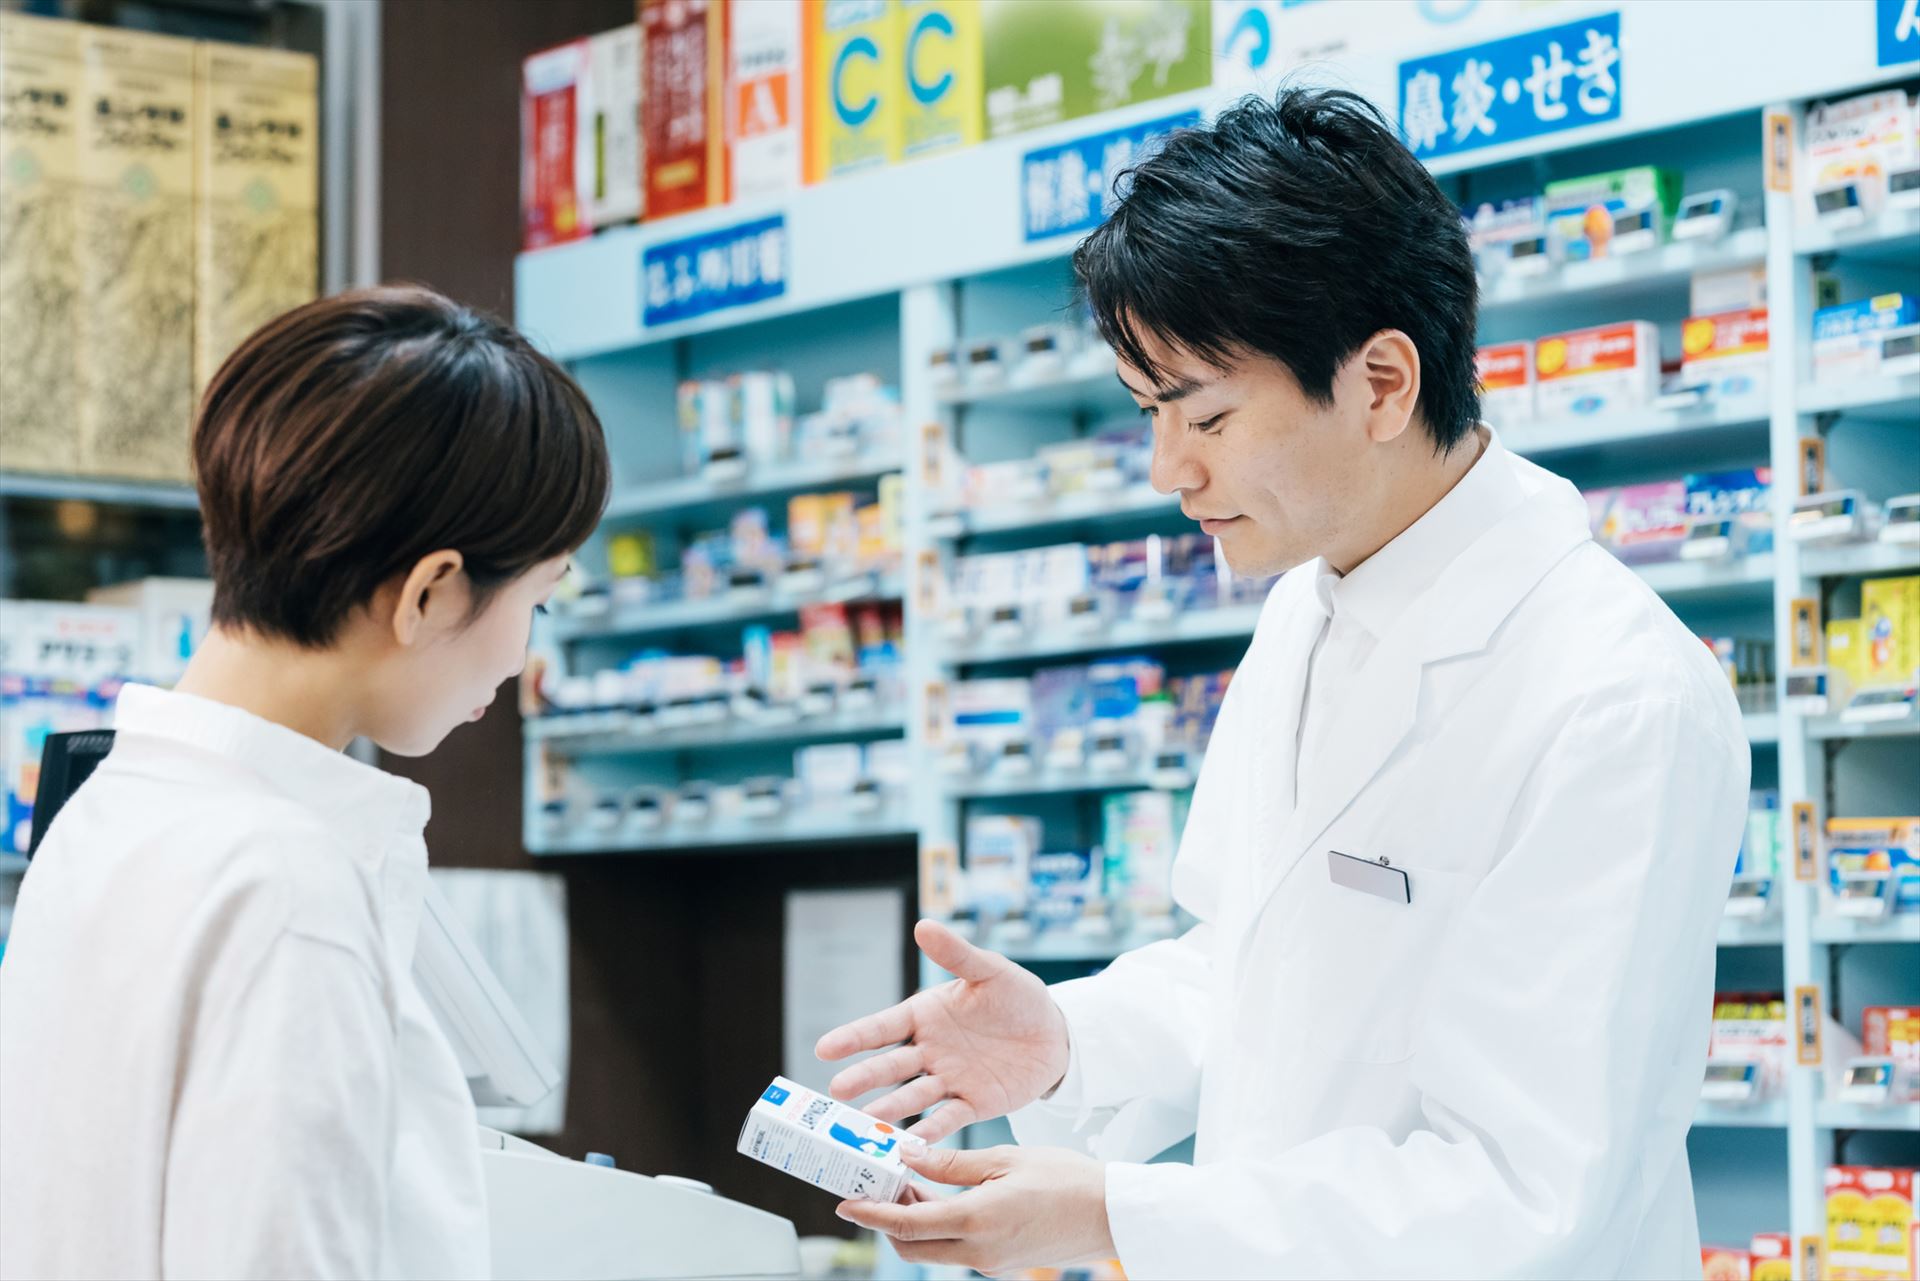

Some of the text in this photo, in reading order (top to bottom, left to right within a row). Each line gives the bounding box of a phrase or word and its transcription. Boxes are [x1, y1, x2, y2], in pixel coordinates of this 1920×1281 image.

[831, 36, 878, 127] C
[905, 11, 954, 104] C
[1403, 28, 1619, 154] 鼻炎・せき
